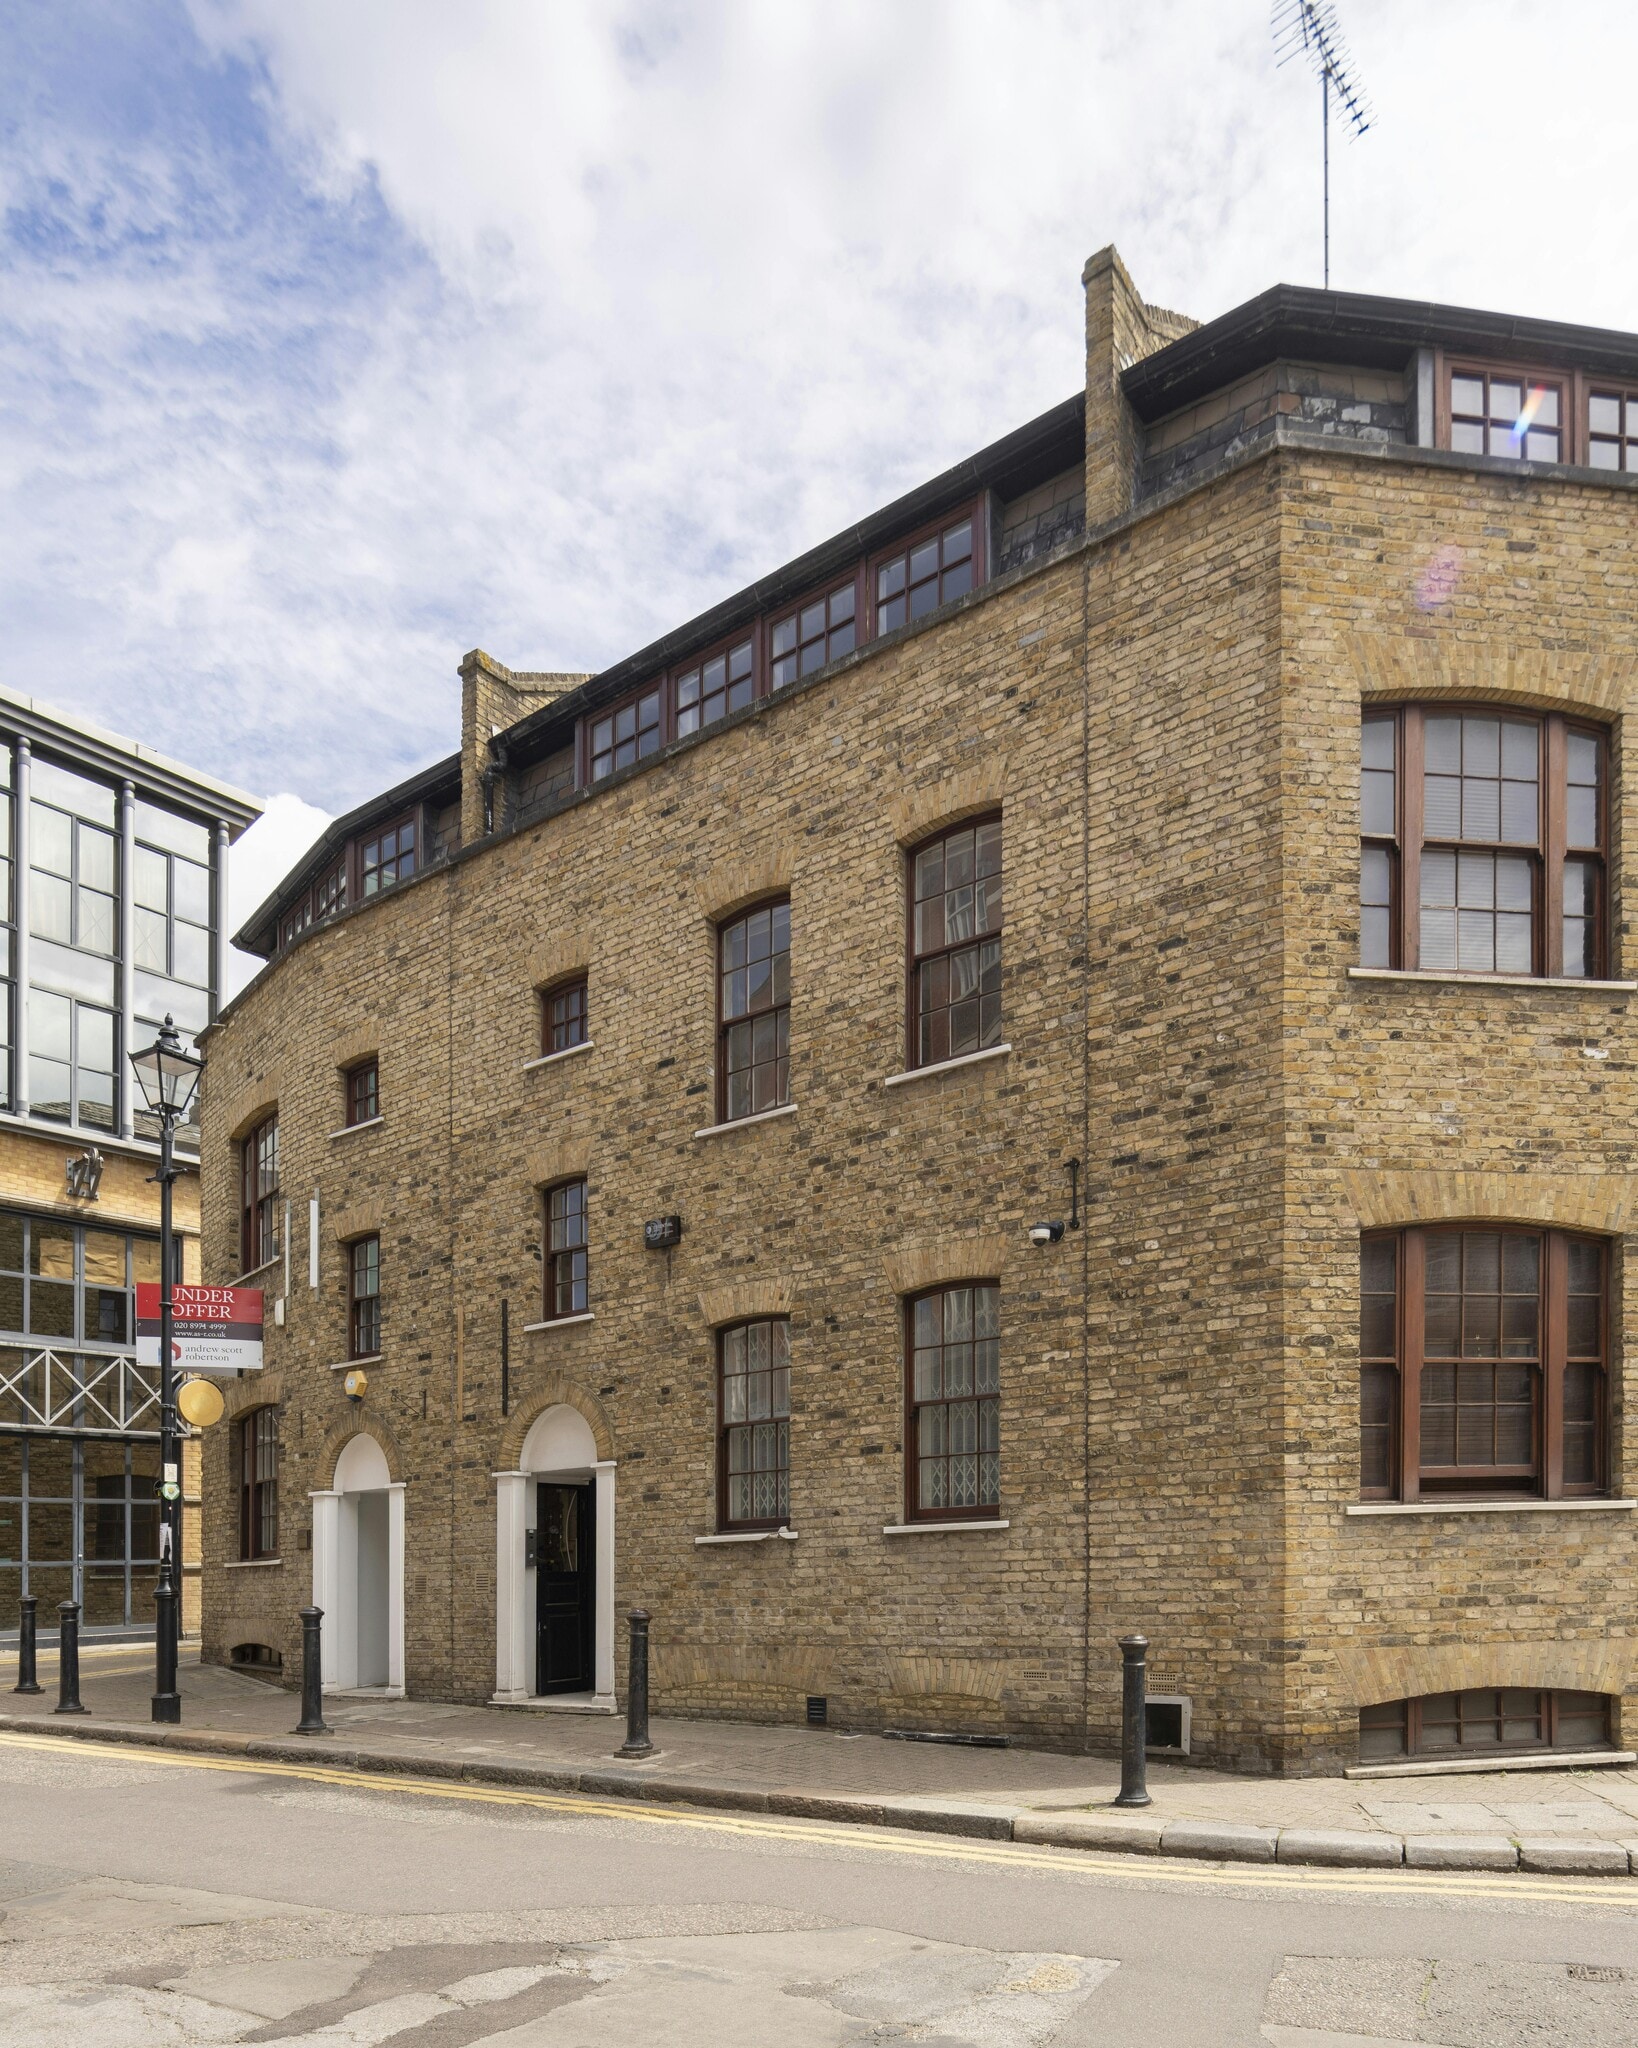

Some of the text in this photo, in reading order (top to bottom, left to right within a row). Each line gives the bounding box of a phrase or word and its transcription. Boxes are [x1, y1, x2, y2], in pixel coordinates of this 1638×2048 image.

[171, 1303, 232, 1318] OFFER
[185, 1345, 218, 1353] andrew
[185, 1353, 229, 1361] robertson
